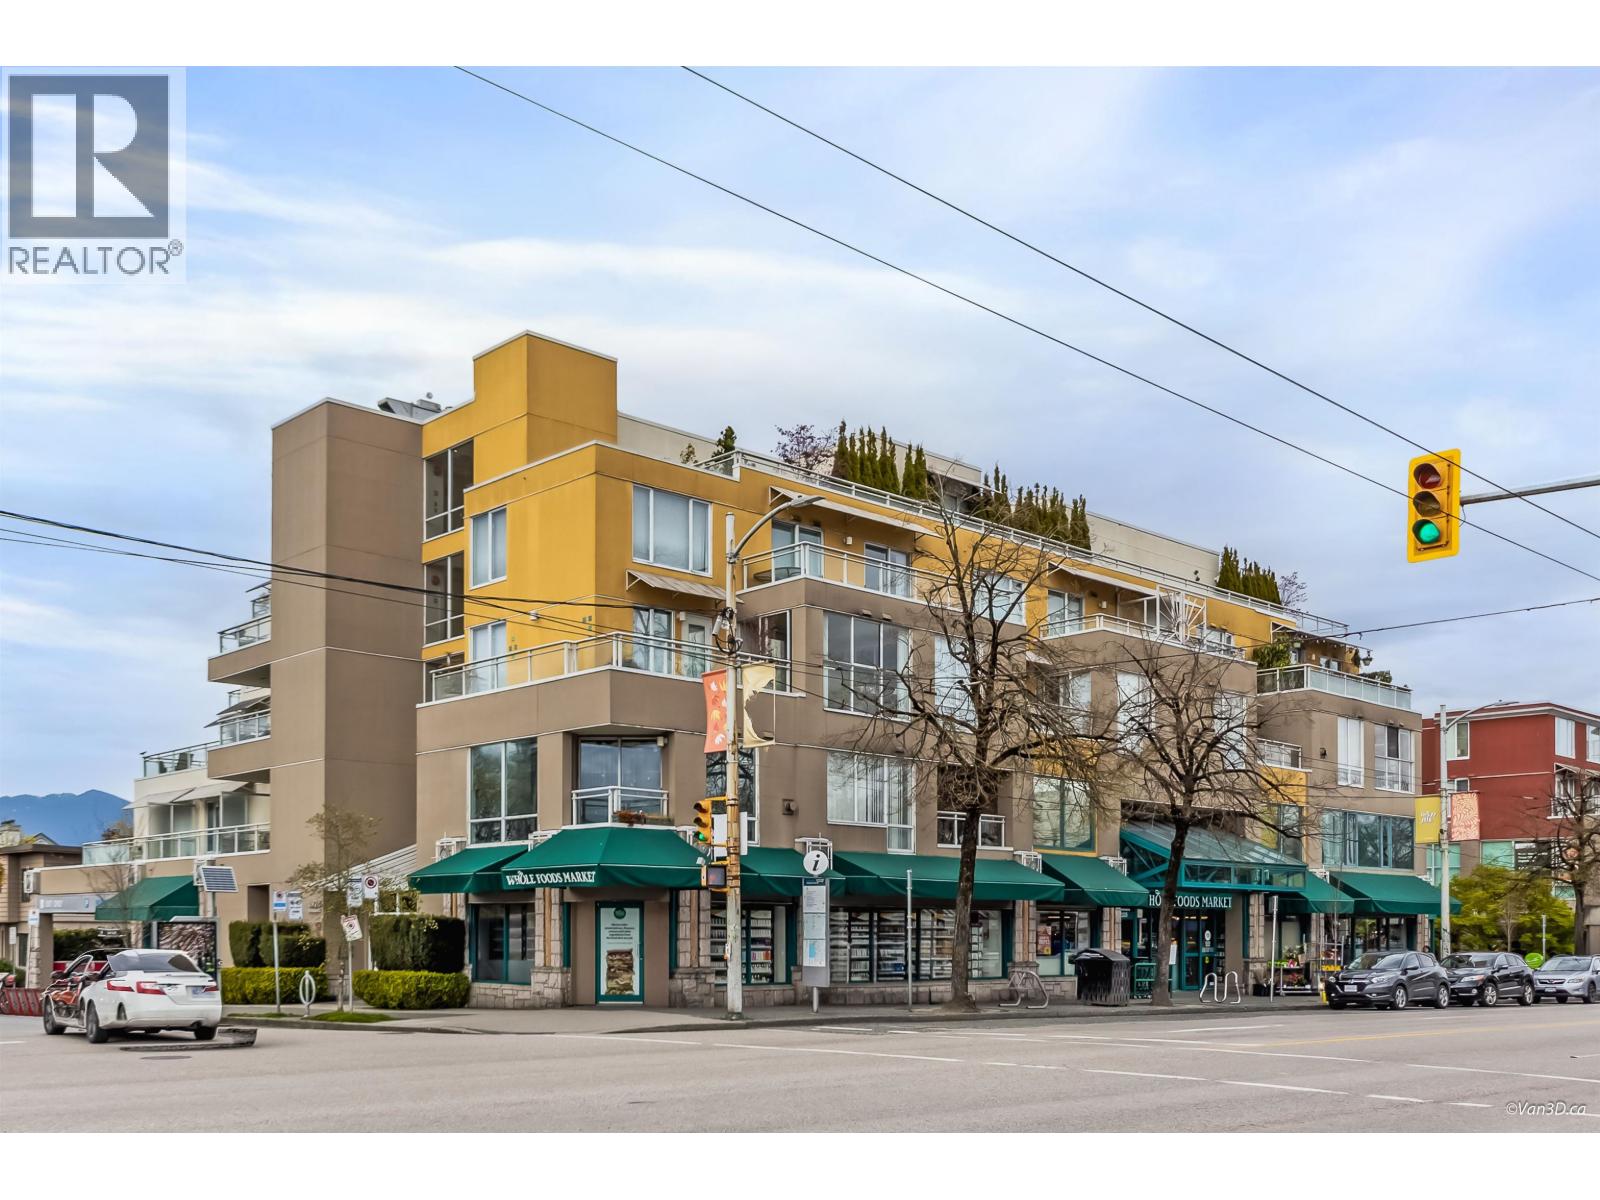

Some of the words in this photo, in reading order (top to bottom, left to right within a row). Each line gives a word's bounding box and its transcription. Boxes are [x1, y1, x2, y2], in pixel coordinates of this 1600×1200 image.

[506, 870, 536, 886] WHOLE
[536, 872, 563, 884] FOODS
[562, 871, 596, 883] MARKET
[1173, 895, 1200, 908] OODS
[1201, 896, 1232, 908] MARKET
